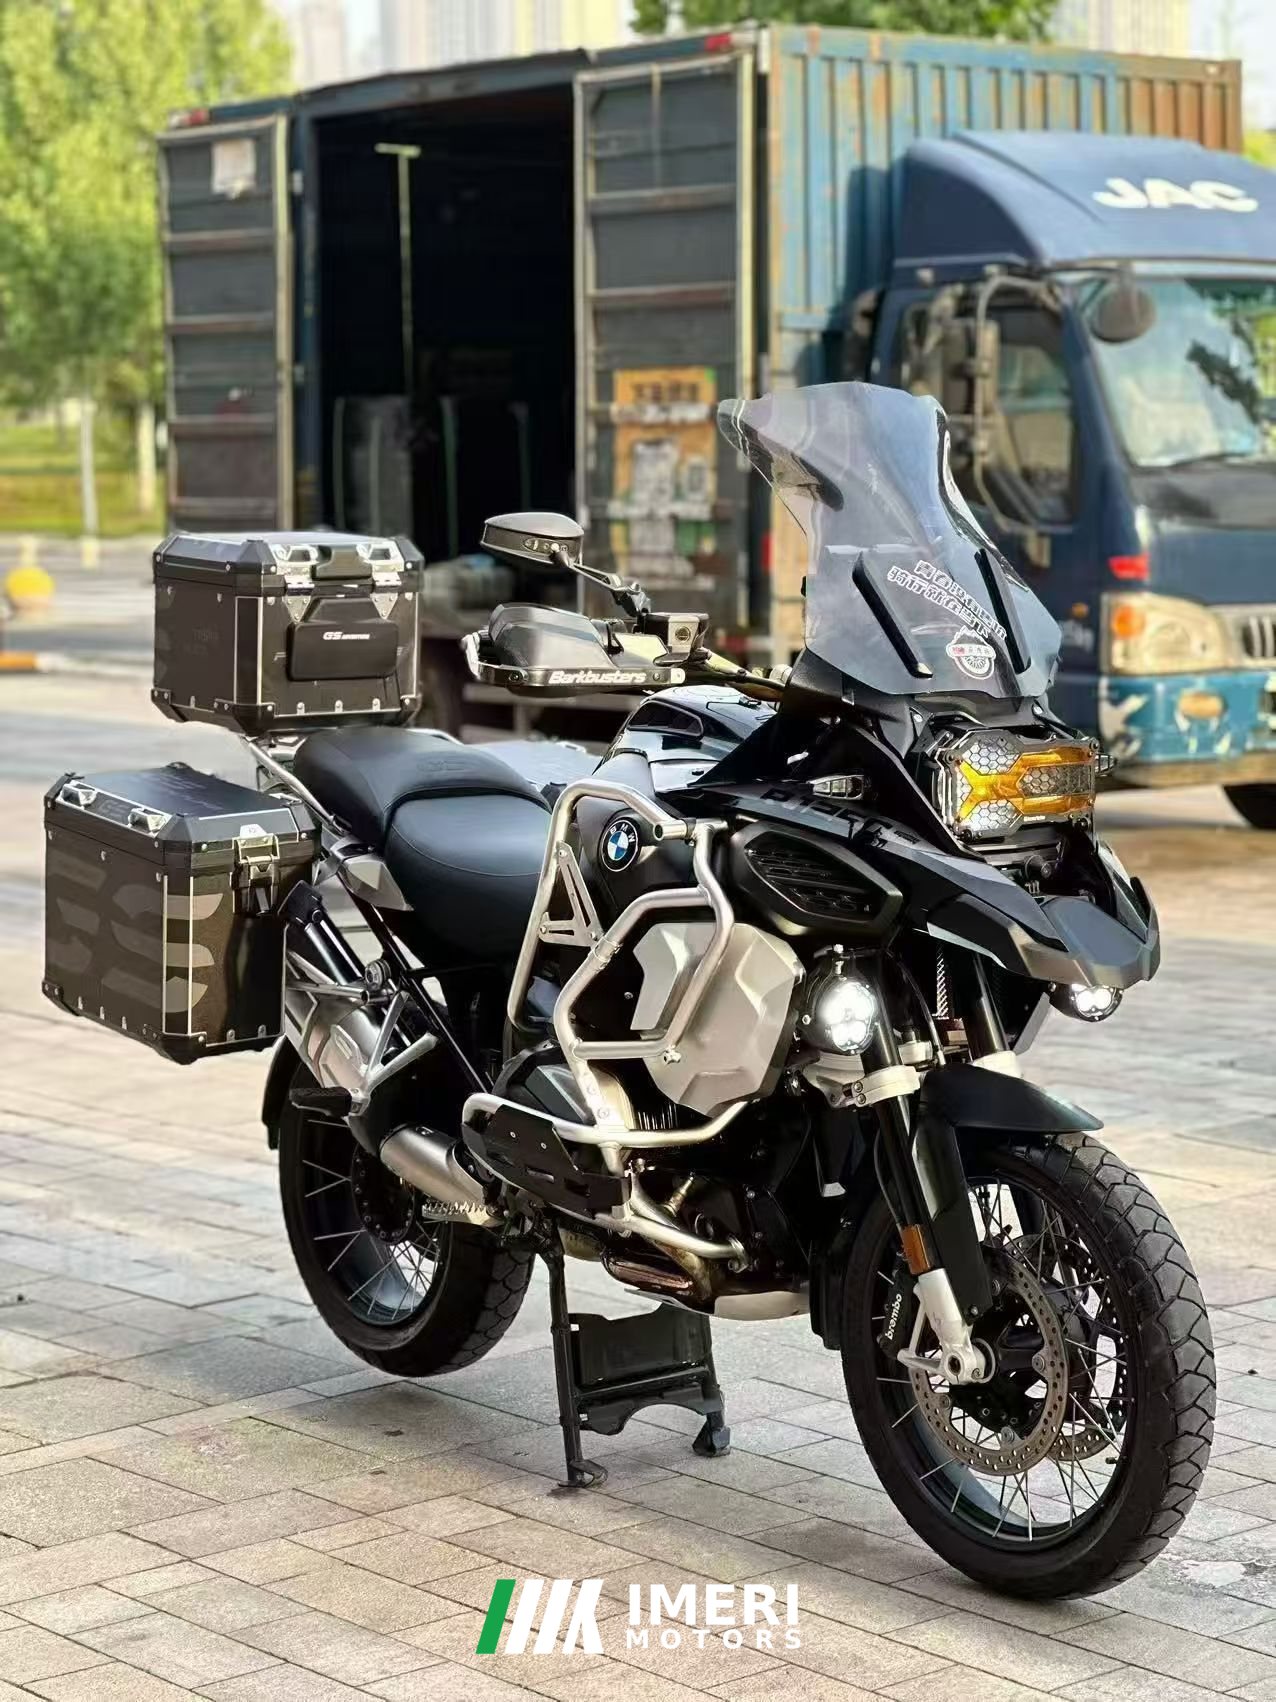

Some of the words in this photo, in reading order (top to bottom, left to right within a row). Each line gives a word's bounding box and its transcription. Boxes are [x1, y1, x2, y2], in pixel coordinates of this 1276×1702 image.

[1091, 177, 1259, 213] JAC
[887, 565, 991, 639] 骑行就在当下
[548, 670, 647, 684] Barkbusters
[609, 823, 636, 843] BMW
[884, 1293, 903, 1341] brembo
